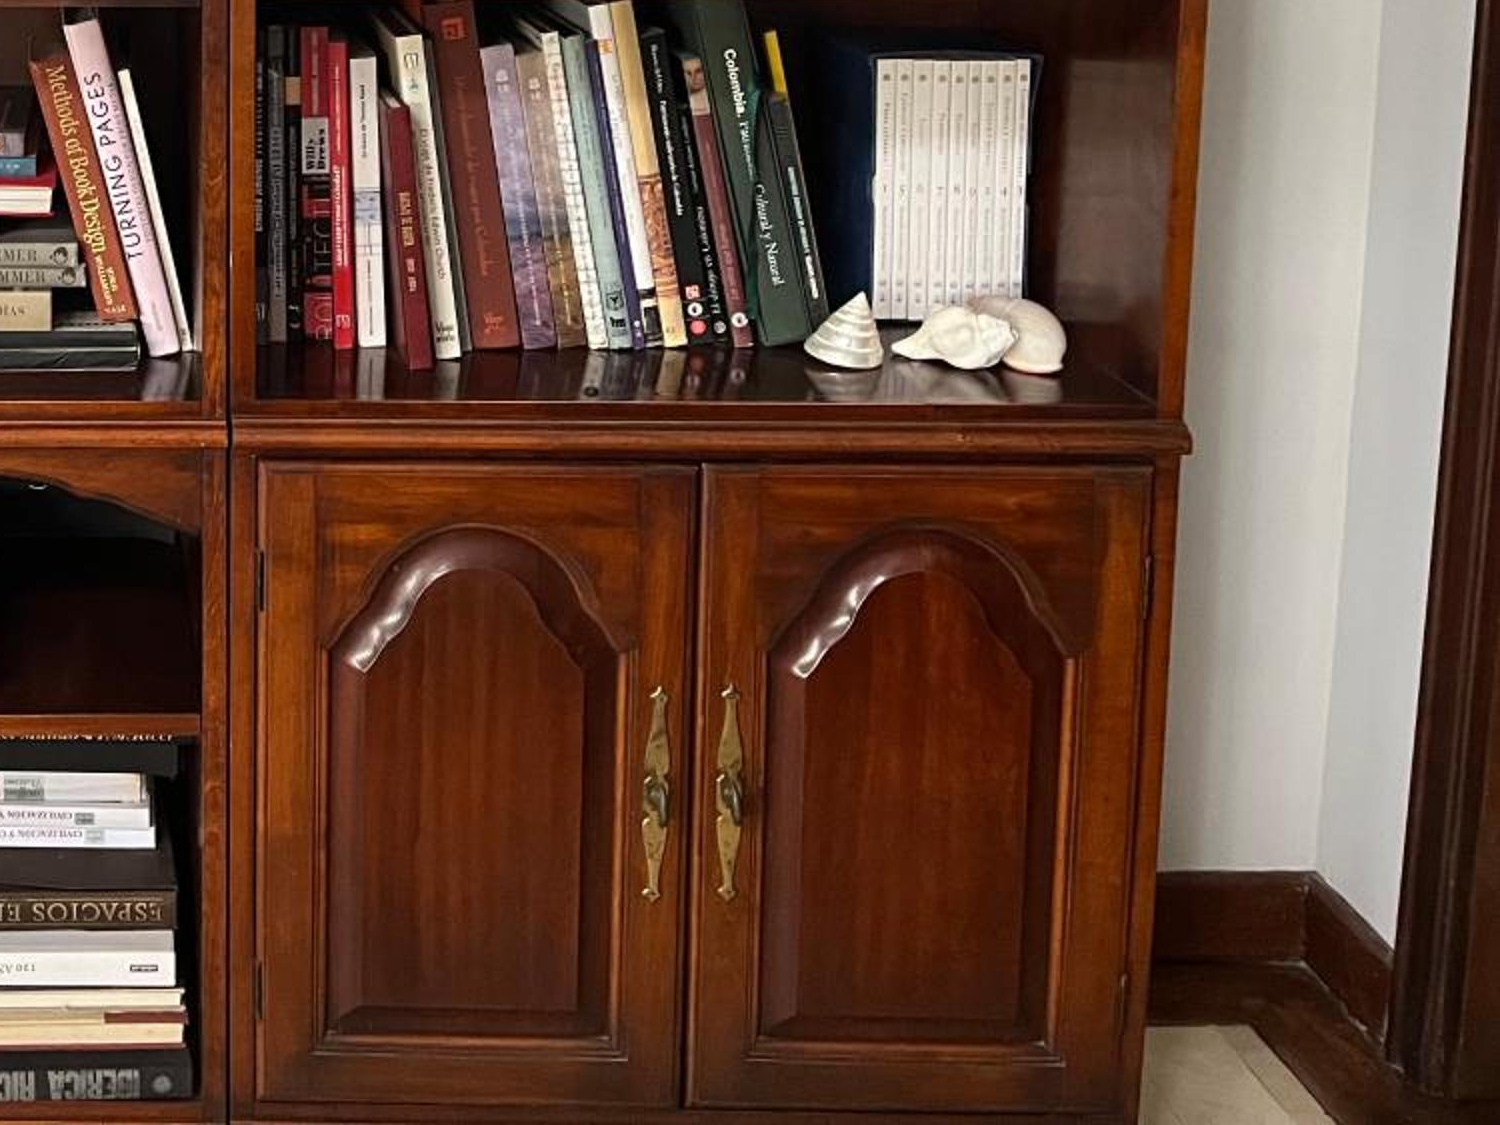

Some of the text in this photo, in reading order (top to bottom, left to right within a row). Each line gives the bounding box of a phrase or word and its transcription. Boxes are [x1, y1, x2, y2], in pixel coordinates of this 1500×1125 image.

[84, 72, 114, 147] PAGES
[46, 65, 106, 252] Methods of Book Design
[305, 140, 316, 169] Willy
[317, 129, 326, 170] Drews
[724, 49, 747, 118] Colombia.
[765, 242, 783, 286] Natural
[104, 155, 143, 260] TURNING
[431, 216, 441, 243] Edwin
[434, 246, 446, 279] Church
[8, 810, 73, 822] CIVILIZACIÓN
[18, 829, 83, 840] CIVILIZACIÓN
[32, 901, 163, 923] ESPACIOS
[47, 1068, 140, 1100] IBERICA
